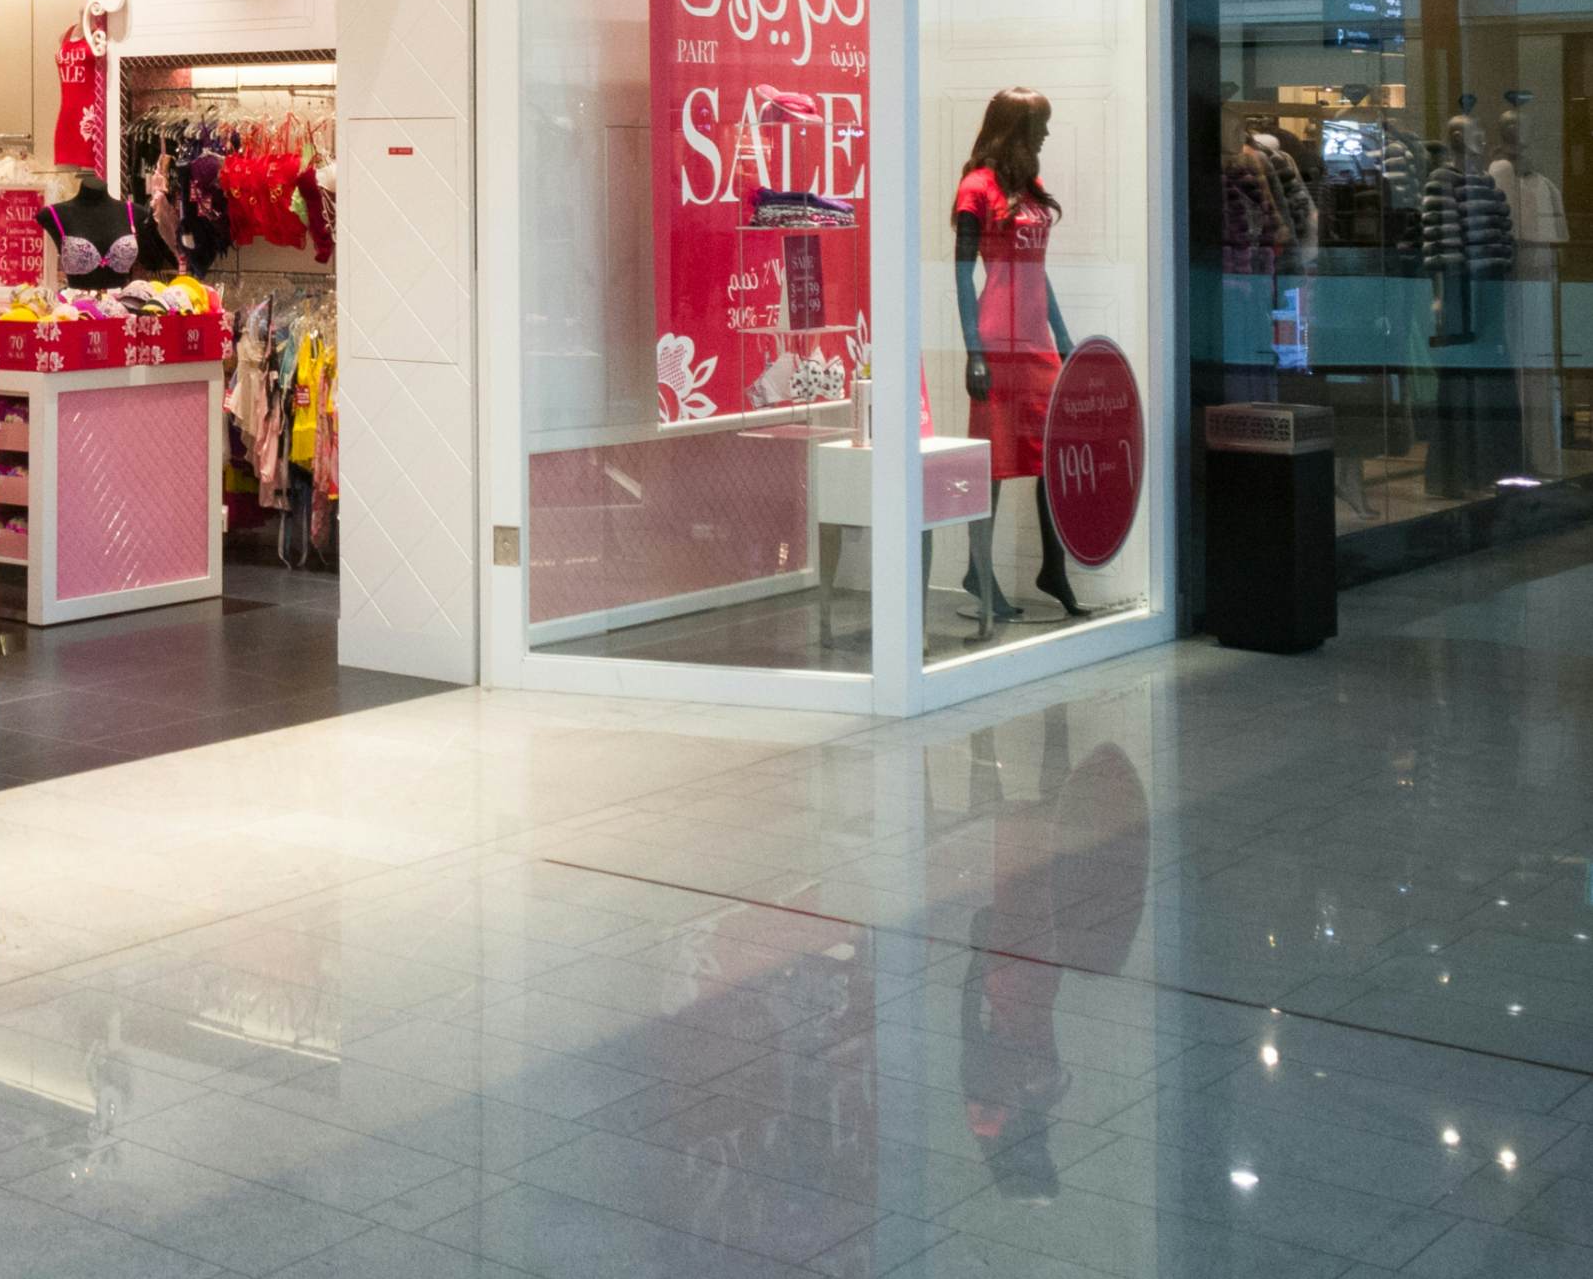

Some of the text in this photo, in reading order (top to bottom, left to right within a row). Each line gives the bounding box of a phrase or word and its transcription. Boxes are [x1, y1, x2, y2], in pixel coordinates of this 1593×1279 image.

[677, 39, 718, 64] PART
[60, 66, 86, 83] ALE
[682, 87, 865, 207] SALE
[6, 206, 38, 221] SALE
[0, 236, 43, 254] 3 139
[0, 254, 8, 271] 6
[21, 255, 43, 272] 199
[727, 304, 782, 329] 30%-75
[10, 335, 23, 350] 70
[88, 331, 100, 345] 70
[187, 329, 199, 342] 80
